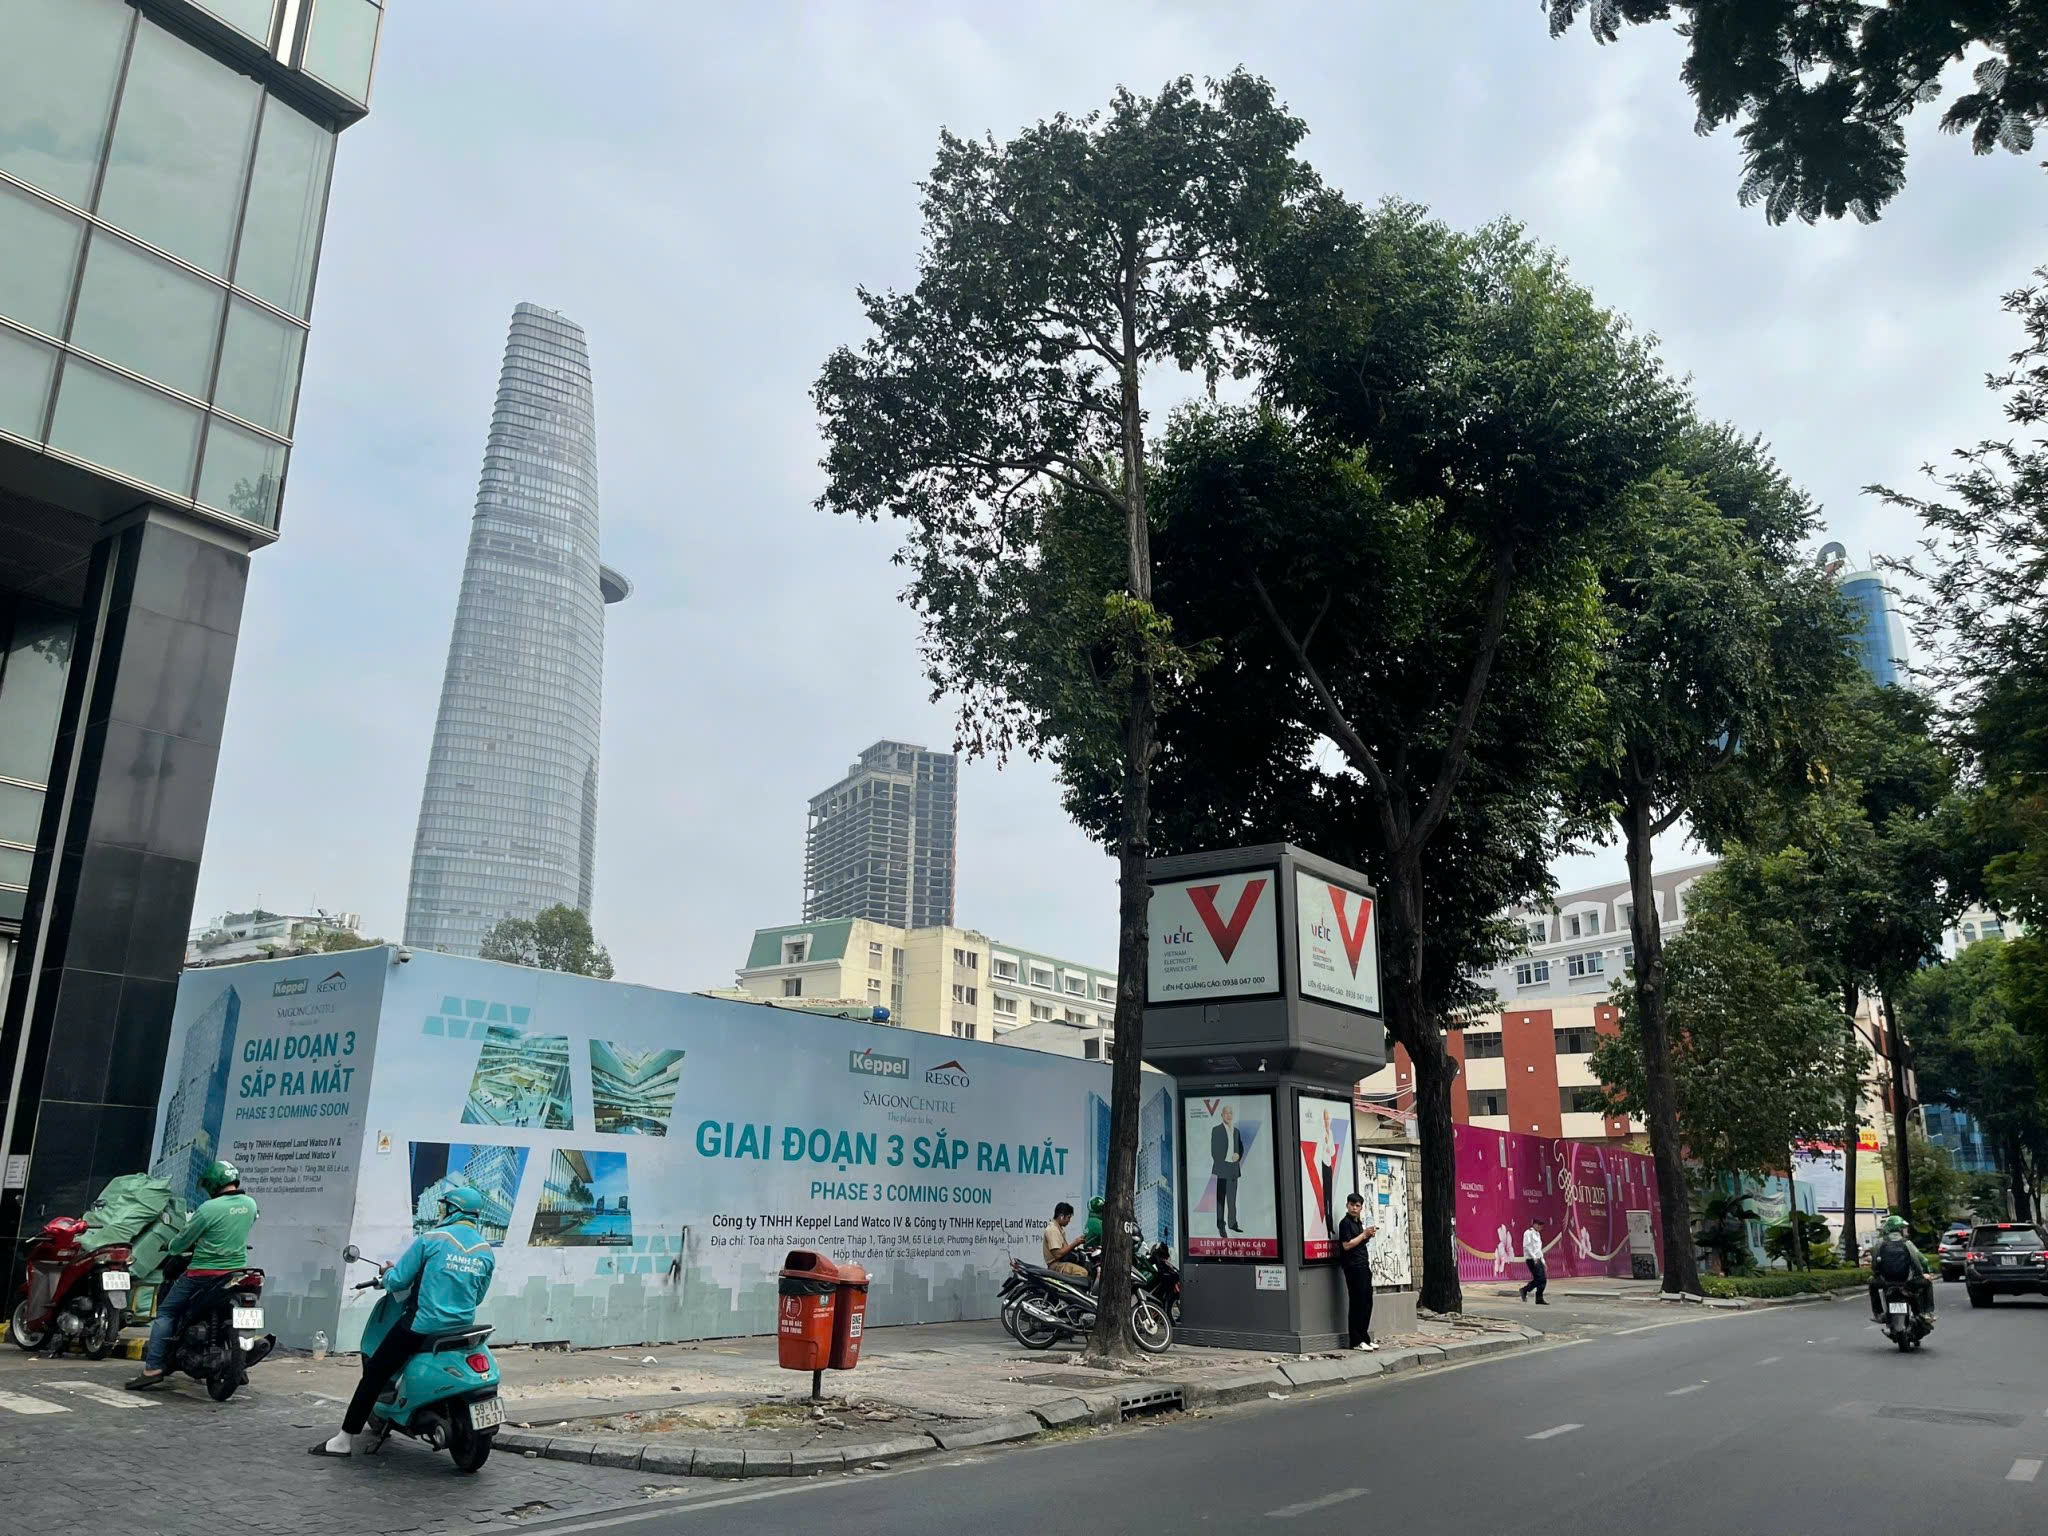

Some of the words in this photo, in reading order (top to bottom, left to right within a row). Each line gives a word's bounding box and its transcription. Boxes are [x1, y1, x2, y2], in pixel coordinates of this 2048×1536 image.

[274, 980, 306, 994] Keppel
[316, 981, 346, 993] RESCO
[1175, 983, 1183, 991] HỆ
[1184, 981, 1206, 990] QUẢNG
[244, 1038, 280, 1063] GIAI
[284, 1032, 338, 1063] ĐOẠN
[343, 1031, 356, 1055] 3
[853, 1053, 906, 1075] Keppel
[240, 1066, 276, 1098] SẮP
[280, 1071, 304, 1096] RA
[310, 1060, 355, 1094] MẮT
[925, 1071, 970, 1088] RESCO
[236, 1106, 267, 1120] PHASE
[269, 1105, 275, 1119] 3
[277, 1104, 317, 1118] COMING
[320, 1103, 349, 1116] SOON
[888, 1112, 899, 1122] The
[900, 1113, 917, 1124] place
[233, 1140, 247, 1150] Công
[248, 1141, 253, 1150] ty
[256, 1140, 272, 1148] TNHH
[272, 1139, 293, 1149] Keppel
[293, 1138, 308, 1147] Land
[309, 1138, 328, 1147] Watco
[328, 1138, 335, 1146] IV
[336, 1138, 341, 1146] &
[696, 1120, 771, 1160] GIAI
[782, 1126, 877, 1171] ĐOẠN
[887, 1134, 904, 1167] 3
[912, 1127, 969, 1170] SẮP
[977, 1141, 1011, 1173] RA
[1018, 1137, 1069, 1175] MẮT
[235, 1153, 249, 1162] Công
[250, 1153, 256, 1162] ty
[257, 1152, 273, 1160] TNHH
[275, 1151, 295, 1161] Keppel
[295, 1151, 310, 1160] Land
[311, 1151, 330, 1159] Watco
[331, 1150, 337, 1159] V
[810, 1181, 869, 1201] PHASE
[873, 1183, 882, 1201] 3
[887, 1184, 949, 1204] COMING
[952, 1186, 992, 1205] SOON
[1592, 1187, 1606, 1204] 2025
[229, 1205, 248, 1215] Grab
[712, 1214, 743, 1230] Công
[746, 1215, 757, 1230] ty
[760, 1214, 792, 1228] TNHH
[795, 1215, 831, 1231] Keppel
[834, 1215, 858, 1228] Land
[861, 1216, 890, 1228] Watco
[893, 1216, 903, 1228] IV
[904, 1216, 912, 1228] &
[914, 1216, 937, 1231] Công
[939, 1217, 947, 1231] ty
[950, 1217, 973, 1229] TNHH
[976, 1217, 1003, 1231] Keppel
[1004, 1218, 1023, 1229] Land
[1025, 1218, 1048, 1229] Watco
[711, 1235, 727, 1247] Địa
[729, 1235, 746, 1246] chỉ:
[749, 1235, 765, 1246] Tòa
[767, 1235, 784, 1246] nhà
[786, 1235, 816, 1248] Saigon
[818, 1235, 845, 1246] Centre
[847, 1235, 867, 1248] Tháp
[869, 1235, 876, 1247] 1,
[877, 1235, 896, 1246] Tầng
[912, 1235, 921, 1245] 65
[923, 1235, 932, 1245] Lê
[947, 1235, 973, 1247] Phường
[975, 1234, 988, 1245] Bến
[1007, 1235, 1024, 1246] Quận
[1200, 1239, 1215, 1247] LIÊN
[1216, 1239, 1226, 1249] HỆ
[1228, 1239, 1251, 1248] QUẢNG
[1252, 1239, 1266, 1248] CÁO
[447, 1254, 471, 1265] XANH
[833, 1249, 850, 1261] Hộp
[852, 1249, 866, 1259] thư
[867, 1249, 883, 1259] điện
[896, 1249, 971, 1261] sc3@kepland.com.vn
[446, 1263, 458, 1271] xin
[474, 1400, 499, 1416] 59-TA
[475, 1411, 503, 1428] 175.37
